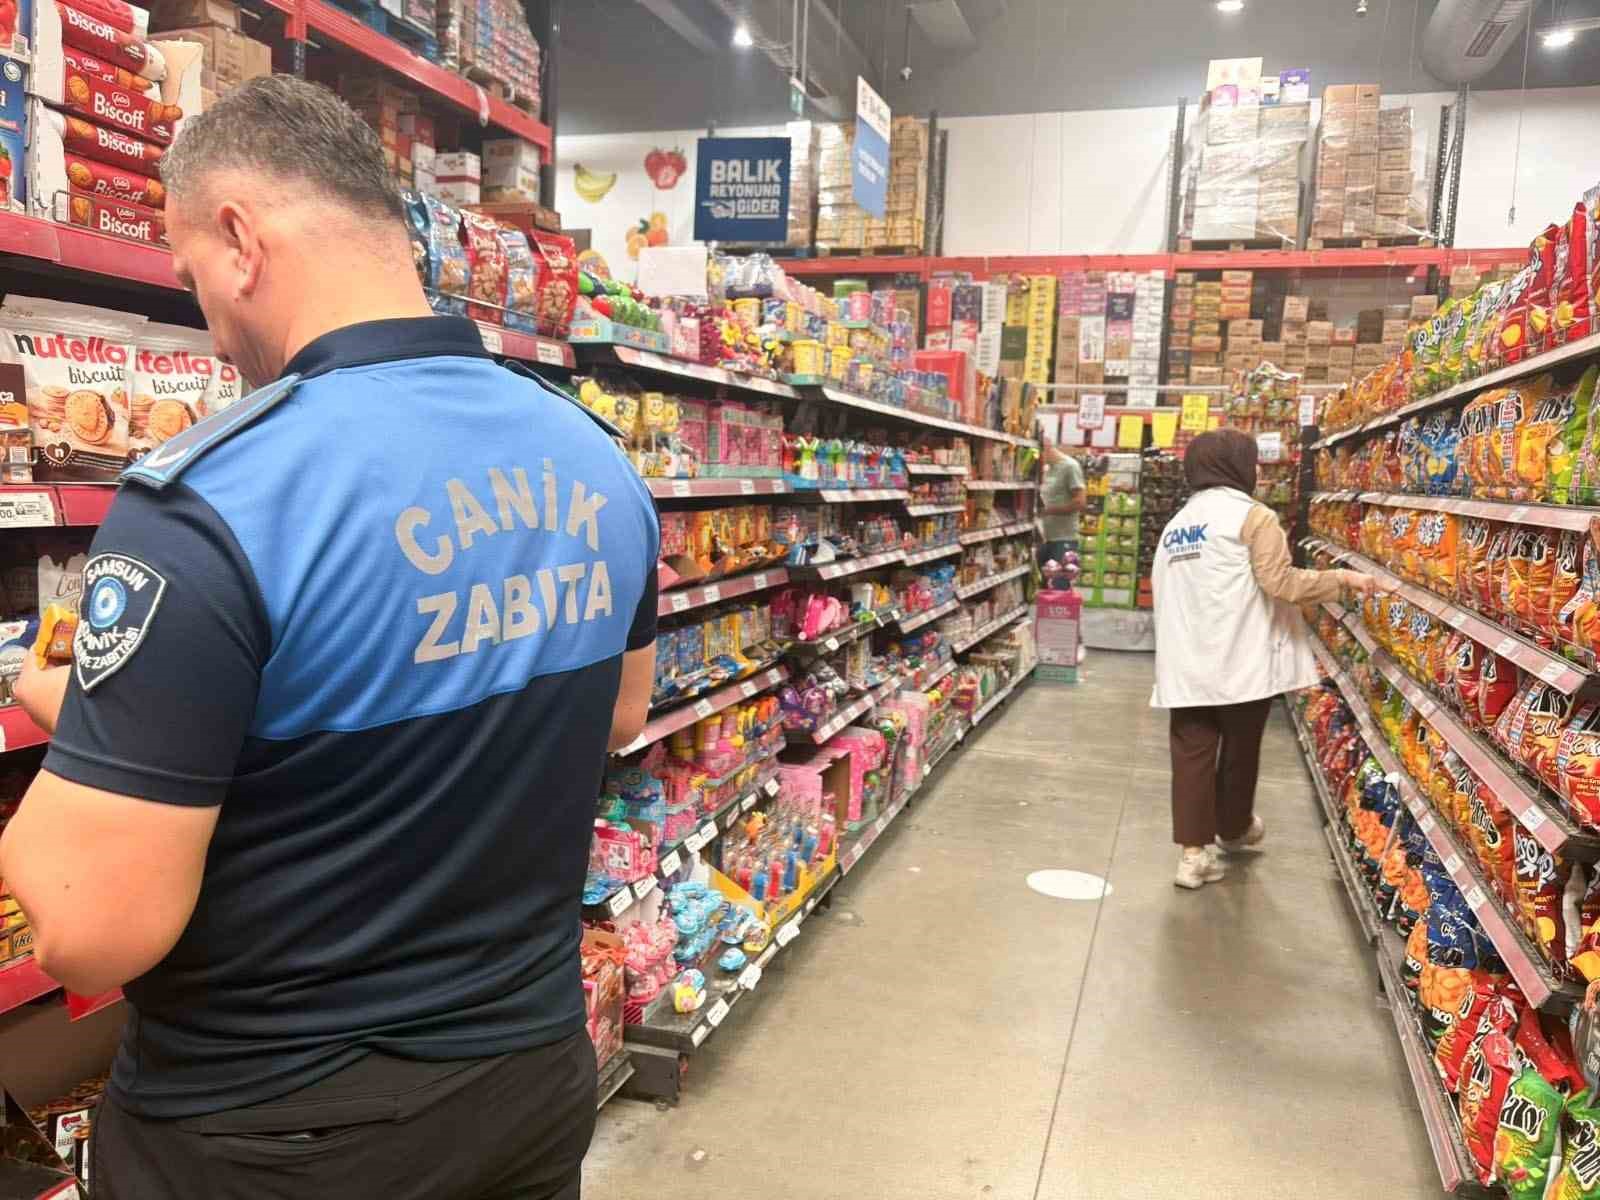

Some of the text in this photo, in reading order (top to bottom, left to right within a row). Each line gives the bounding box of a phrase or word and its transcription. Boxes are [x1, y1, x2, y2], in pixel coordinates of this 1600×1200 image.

[64, 6, 116, 43] Biscoff
[94, 91, 145, 131] Biscoff
[97, 127, 144, 159] Biscoff
[710, 159, 783, 183] BALIK
[710, 184, 781, 197] REYONUNA
[100, 209, 151, 240] Biscoff
[14, 334, 128, 365] nutella
[69, 365, 125, 384] biscuit
[152, 377, 208, 394] biscuit
[395, 457, 608, 576] CANİK
[87, 559, 149, 591] SAMSUN
[413, 560, 613, 664] ZABITA
